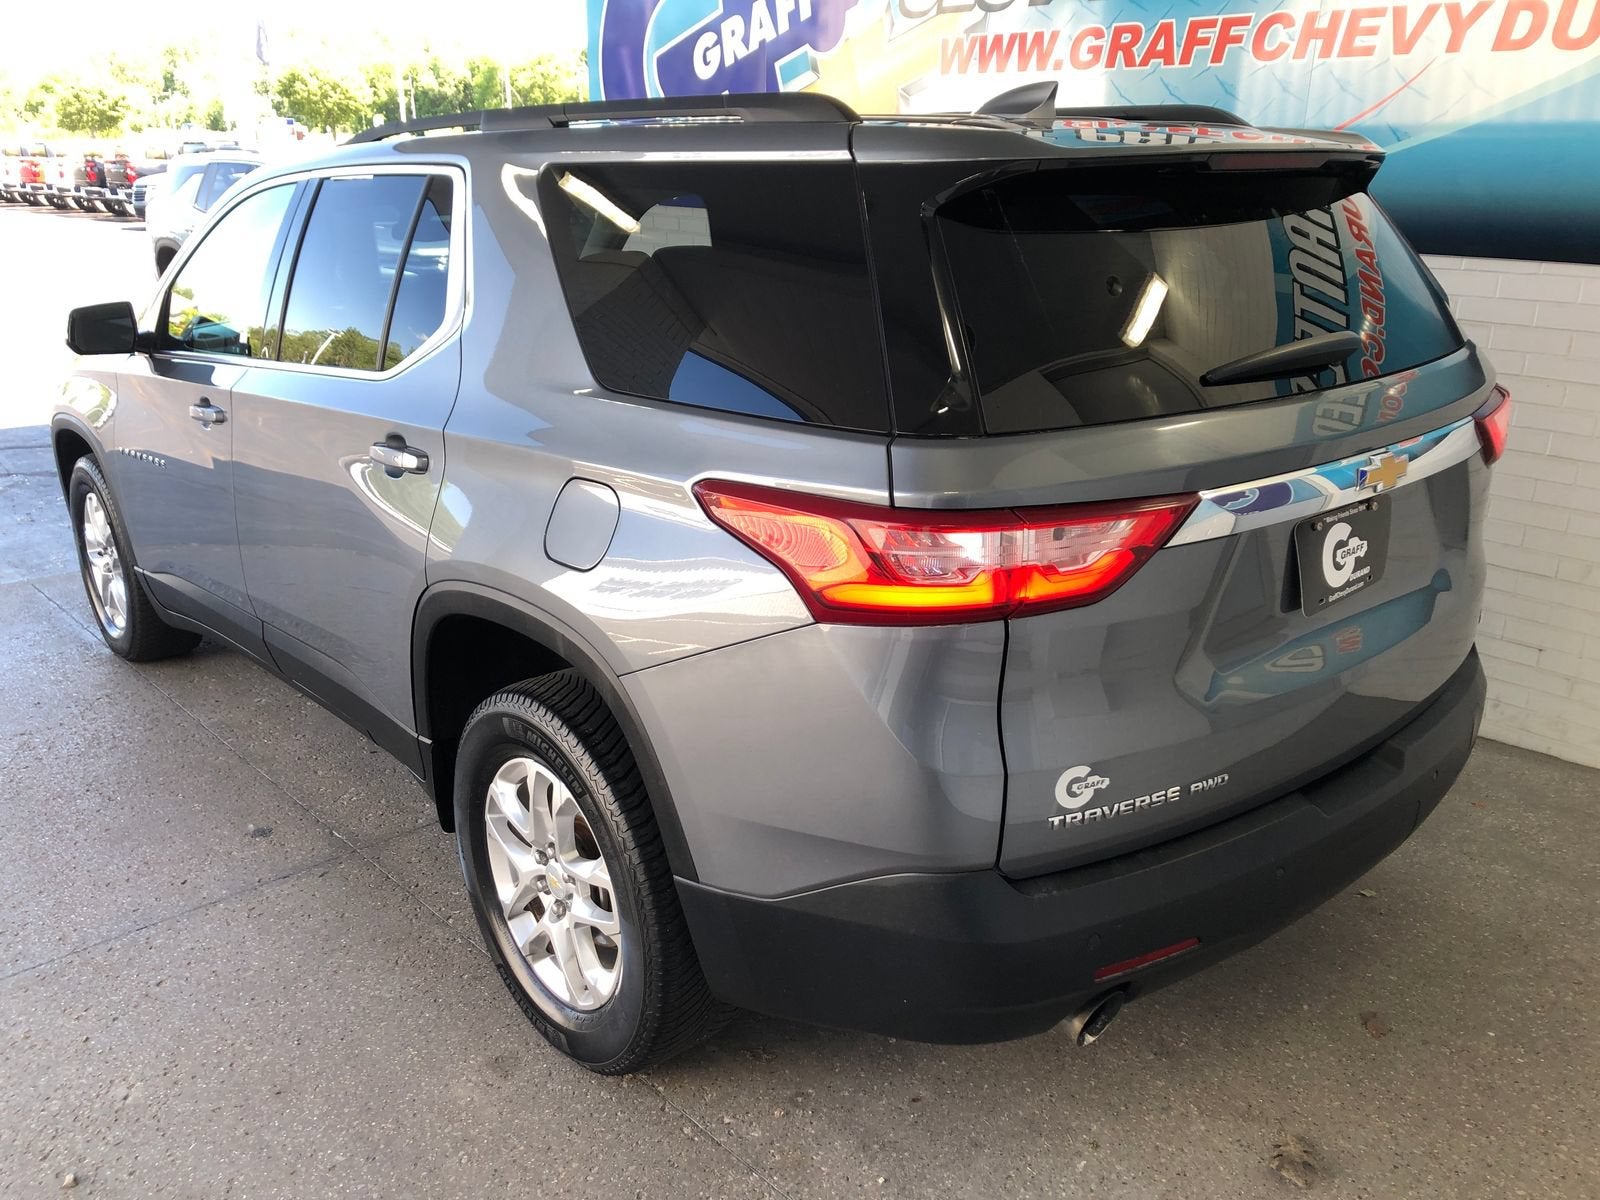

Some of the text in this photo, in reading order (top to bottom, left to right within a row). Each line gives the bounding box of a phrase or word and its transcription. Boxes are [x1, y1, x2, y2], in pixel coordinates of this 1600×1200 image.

[1341, 543, 1365, 559] GRAFF
[525, 729, 585, 797] MICHELIN
[1048, 773, 1230, 831] TRAVERSE AWD
[1076, 779, 1107, 791] GRAFF
